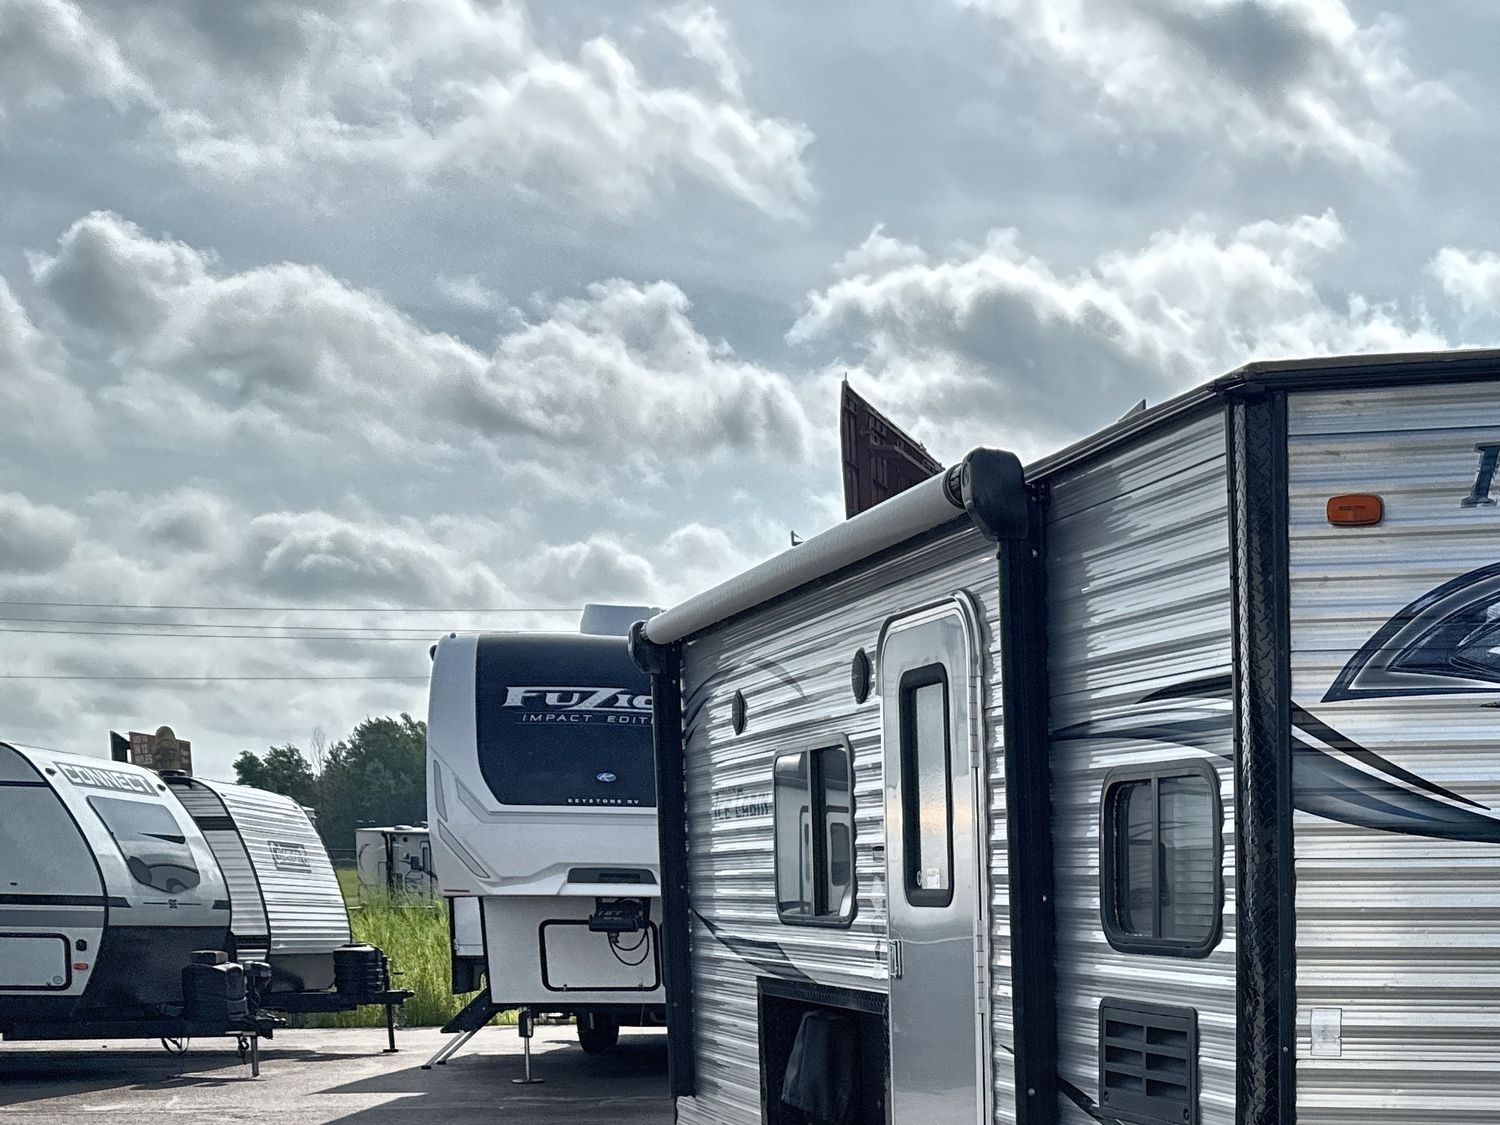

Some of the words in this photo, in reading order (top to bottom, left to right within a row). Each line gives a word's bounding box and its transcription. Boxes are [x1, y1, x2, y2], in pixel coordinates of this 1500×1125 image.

[502, 686, 653, 713] FUZIO
[522, 714, 593, 722] IMPACT
[57, 763, 153, 794] CONNECT
